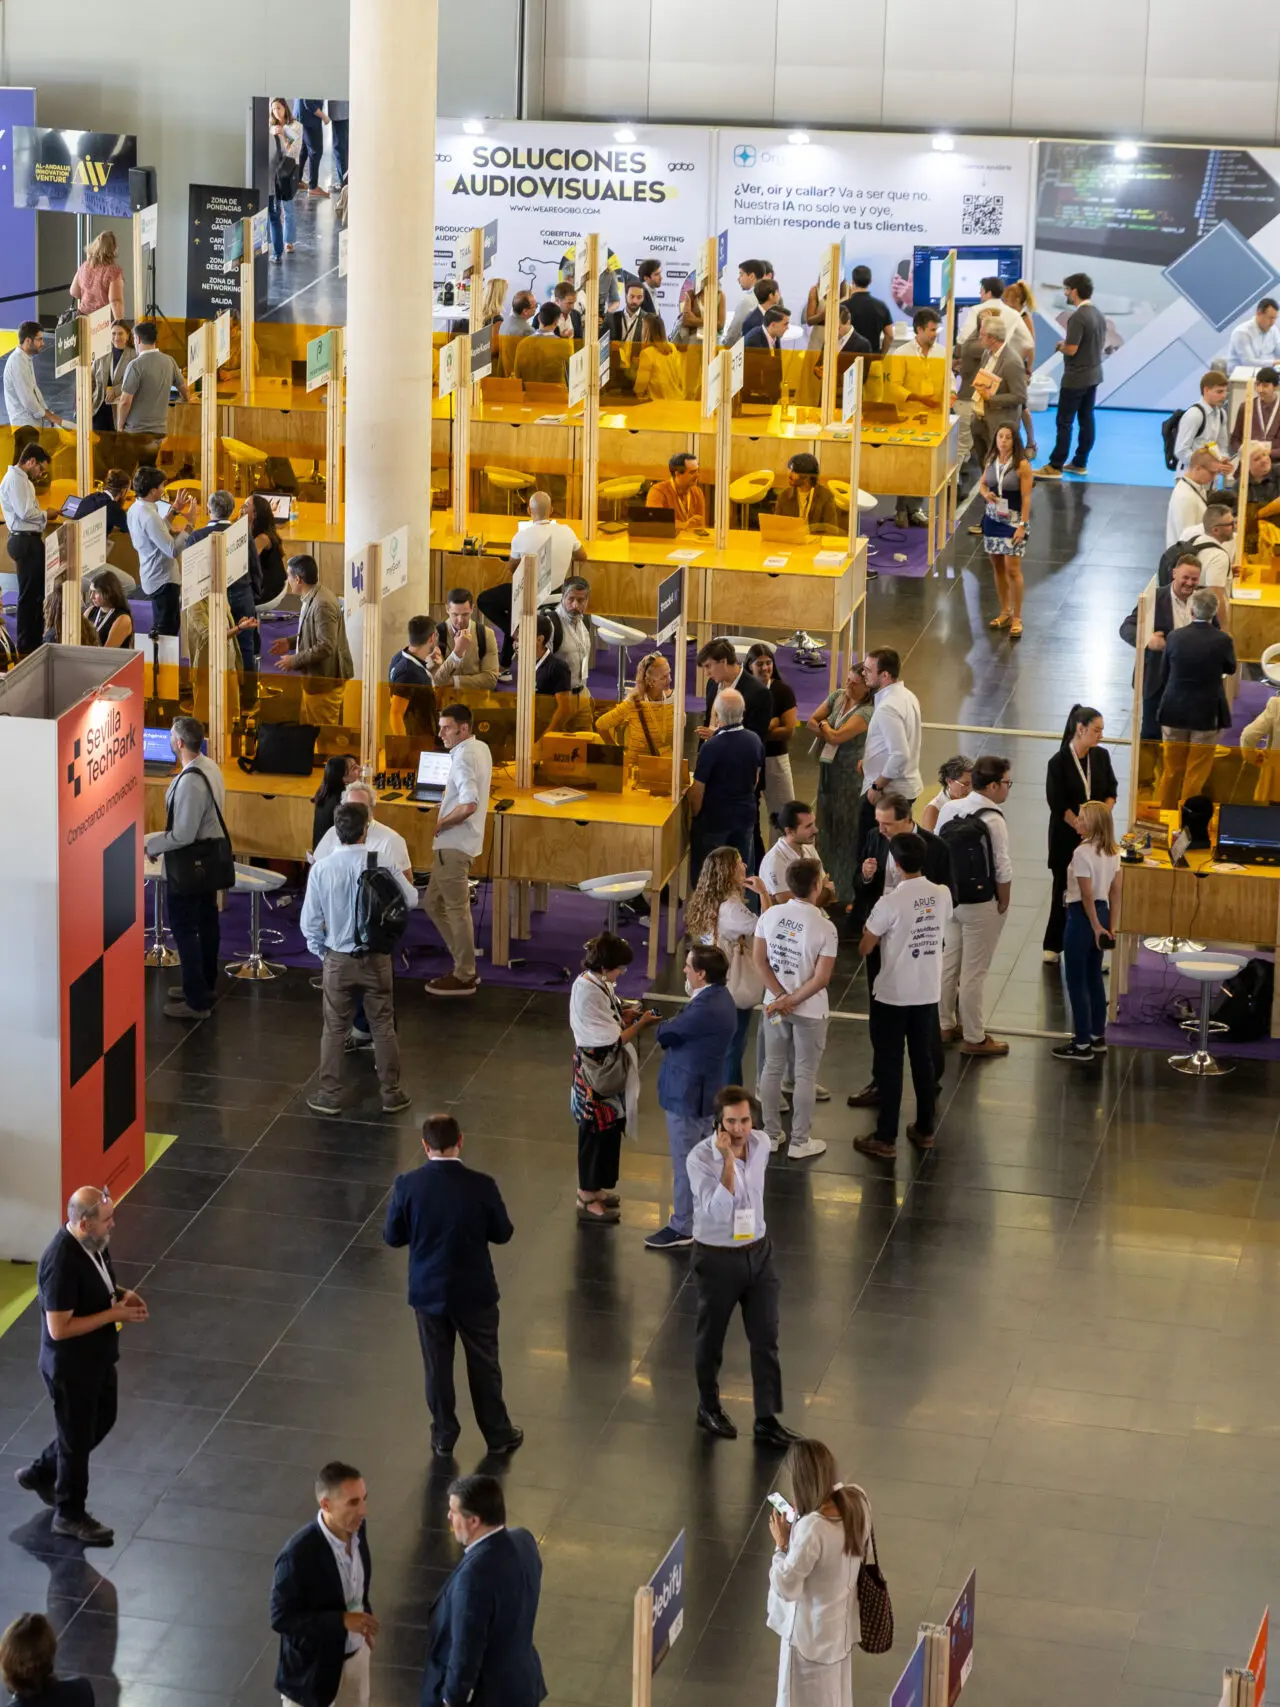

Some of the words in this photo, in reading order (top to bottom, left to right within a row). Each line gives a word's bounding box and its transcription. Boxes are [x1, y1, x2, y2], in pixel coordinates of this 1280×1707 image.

[472, 146, 646, 173] SOLUCIONES
[36, 175, 67, 183] VENTURE
[452, 174, 666, 204] AUDIOVISUALES
[734, 183, 764, 196] ¿Ver,
[786, 187, 792, 197] y
[796, 186, 835, 197] callar?
[839, 187, 853, 199] Va
[856, 191, 863, 199] a
[866, 191, 883, 200] ser
[887, 192, 910, 202] que
[206, 204, 242, 212] PONENCIAS
[509, 205, 600, 215] WWW.WEAREGOBO.COM
[734, 199, 779, 210] Nuestra
[782, 201, 795, 211] IA
[798, 203, 813, 211] no
[815, 202, 840, 213] solo
[843, 205, 857, 214] ve
[860, 206, 867, 217] y
[869, 206, 894, 218] oye,
[734, 214, 780, 226] también
[783, 217, 841, 230] responde
[843, 221, 850, 229] a
[854, 220, 873, 230] tus
[875, 221, 928, 232] clientes.
[540, 229, 581, 238] COBERTURA
[643, 235, 685, 243] MARKETING
[649, 244, 677, 252] DIGITAL
[85, 707, 122, 756] Sevilla
[86, 723, 137, 787] TechPark
[67, 799, 105, 846] Conectando
[914, 896, 936, 908] ARUS
[779, 918, 804, 931] ARUS
